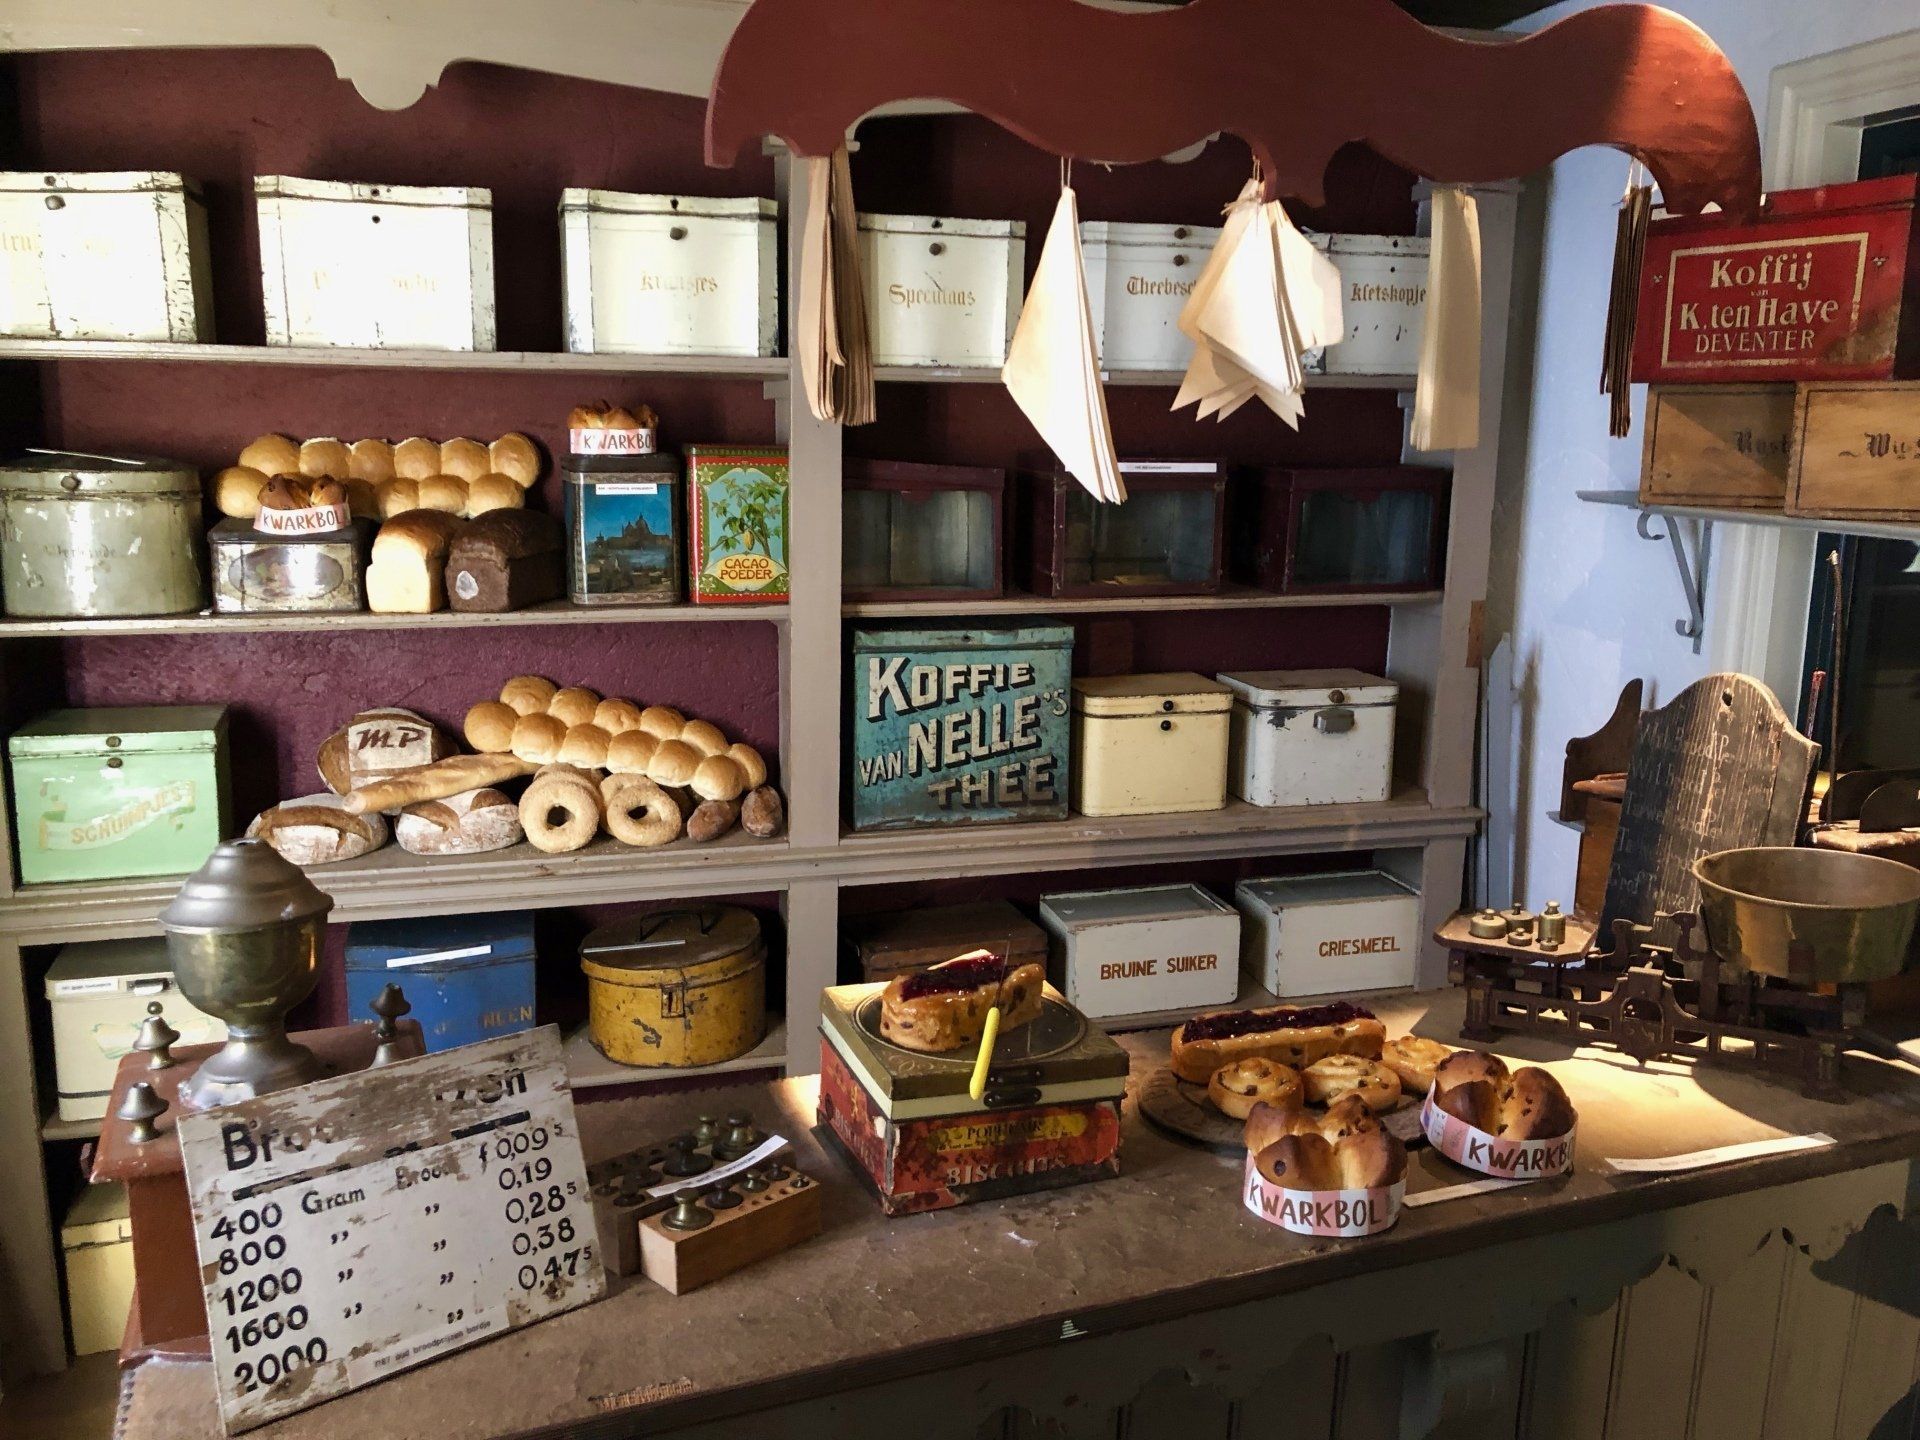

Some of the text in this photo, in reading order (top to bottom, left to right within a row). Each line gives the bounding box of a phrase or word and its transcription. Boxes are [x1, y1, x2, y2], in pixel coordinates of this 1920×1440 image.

[1710, 251, 1813, 290] Koffij
[1350, 283, 1427, 306] Kletskopje
[1711, 303, 1751, 329] ten
[1757, 298, 1839, 327] Have
[1695, 329, 1815, 353] DEVENTER
[263, 510, 343, 531] KWARKBOL
[719, 569, 773, 580] POEDER
[724, 558, 769, 569] CACAO
[867, 656, 1036, 723] KOFFIE
[858, 750, 903, 788] VAN
[928, 753, 1058, 810] THEE
[1100, 954, 1218, 980] BRUINE SUIKER
[210, 1201, 283, 1242] 400
[301, 1187, 367, 1215] Gram
[219, 1233, 287, 1275] 800
[498, 1157, 553, 1190] 0,19
[1249, 1177, 1382, 1229] KWARKBOL
[221, 1266, 303, 1316] 1200
[225, 1304, 309, 1354] 1600
[512, 1217, 576, 1257] 0,38
[233, 1336, 328, 1393] 2000
